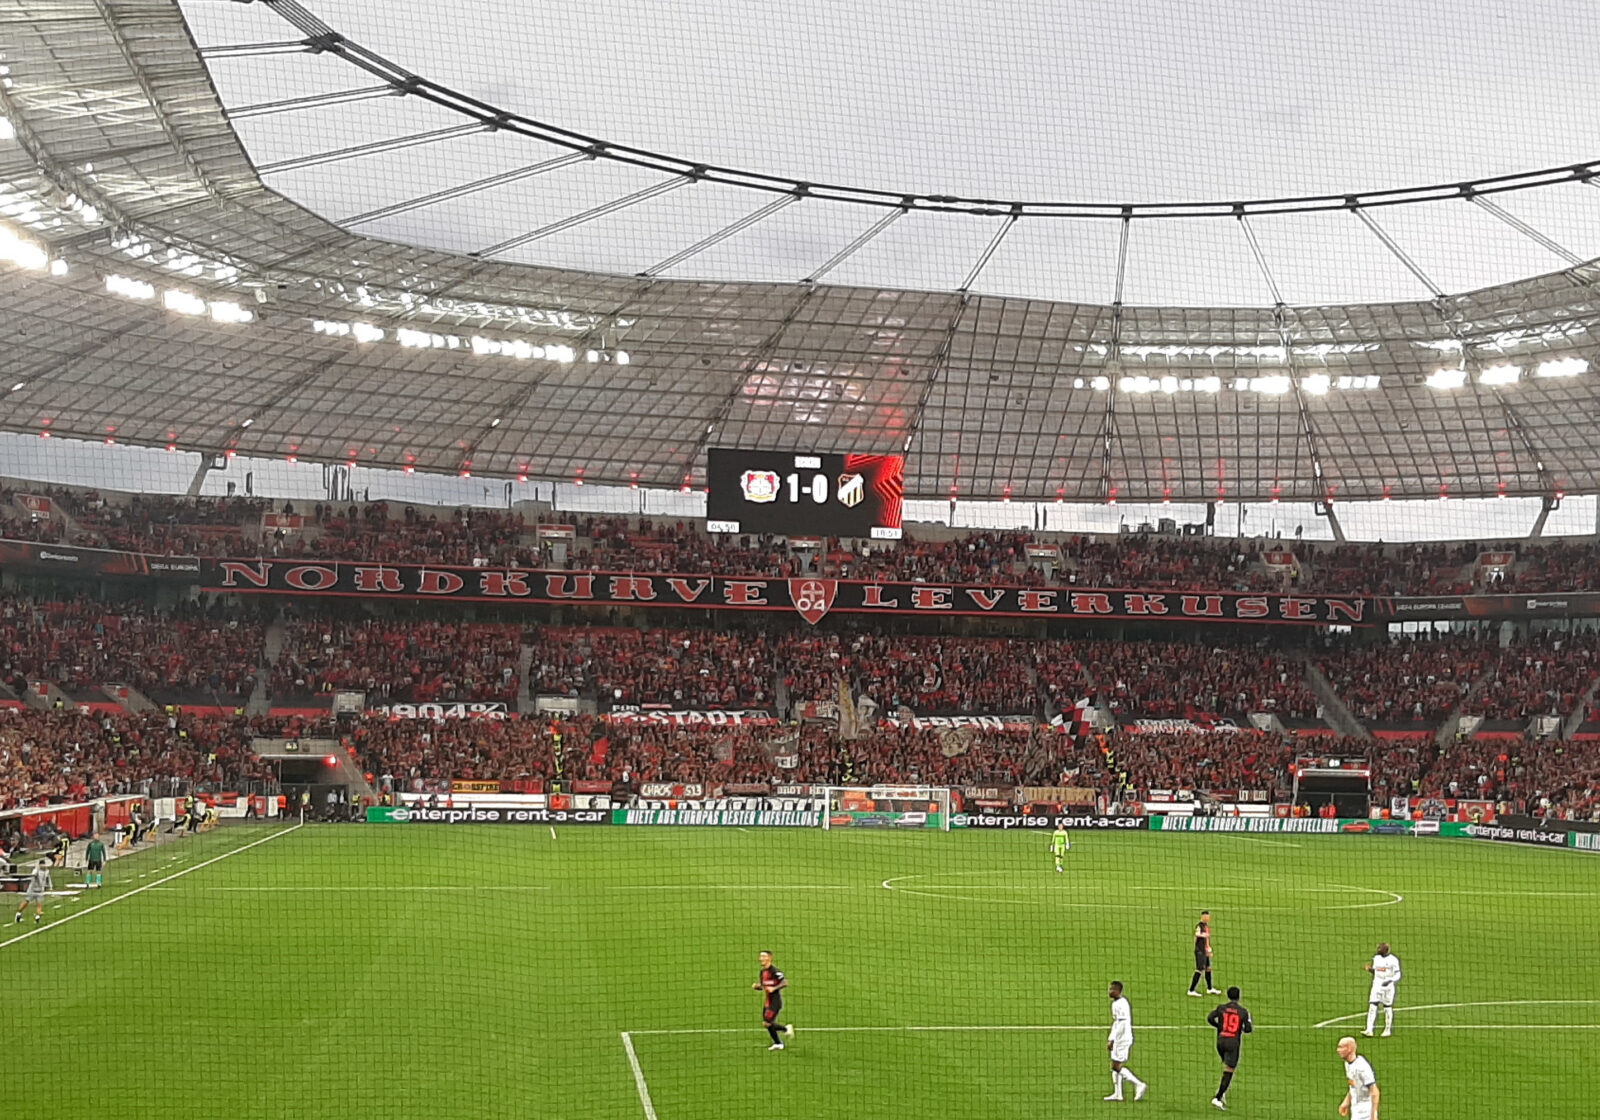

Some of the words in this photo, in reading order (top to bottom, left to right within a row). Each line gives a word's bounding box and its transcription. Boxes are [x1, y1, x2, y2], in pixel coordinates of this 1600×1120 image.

[787, 473, 828, 504] 1-0
[219, 561, 767, 605] NORDKURVE
[862, 585, 1365, 621] LEVERKUSEN
[796, 598, 826, 612] 04
[387, 807, 500, 823] enterprise
[507, 807, 607, 821] rent-a-car
[626, 810, 655, 825] MIETE
[656, 810, 677, 825] AUS
[677, 810, 719, 825] EUROPAS
[721, 811, 755, 825] BESTER
[756, 811, 819, 826] AUFSTELLUNG
[950, 814, 1048, 829] enterprise
[1054, 816, 1144, 828] rent-a-car
[1161, 818, 1188, 831] MIETE
[1189, 818, 1207, 831] AUS
[1208, 818, 1246, 831] EUROPAS
[1249, 819, 1280, 832] BESTER
[1281, 819, 1339, 832] AUFSTELLUNG
[1516, 829, 1565, 843] rent-a-car
[1223, 1012, 1240, 1033] 19
